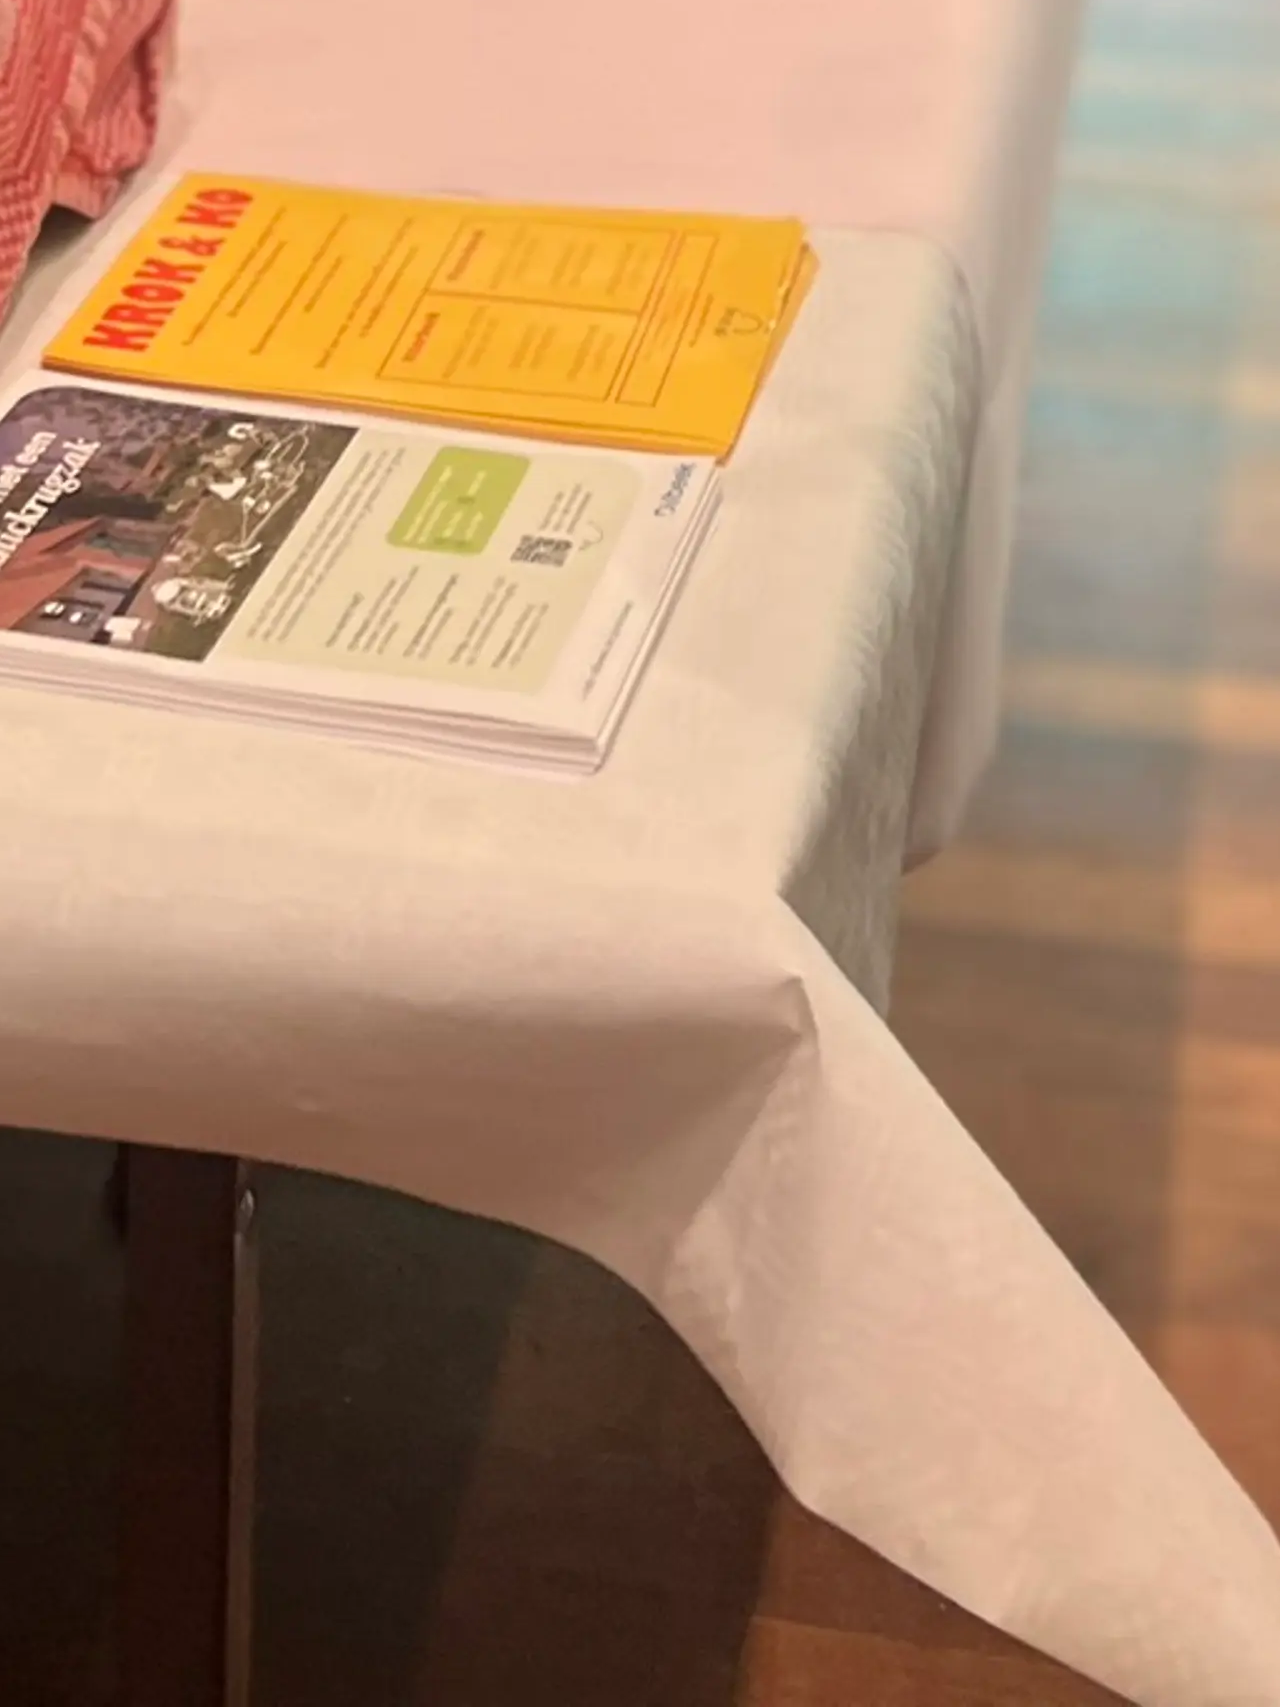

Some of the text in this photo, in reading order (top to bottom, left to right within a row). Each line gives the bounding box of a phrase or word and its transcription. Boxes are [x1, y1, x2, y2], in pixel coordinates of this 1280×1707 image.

[176, 189, 253, 228] KO
[158, 235, 226, 256] &
[83, 258, 206, 352] KROK
[15, 431, 57, 465] een
